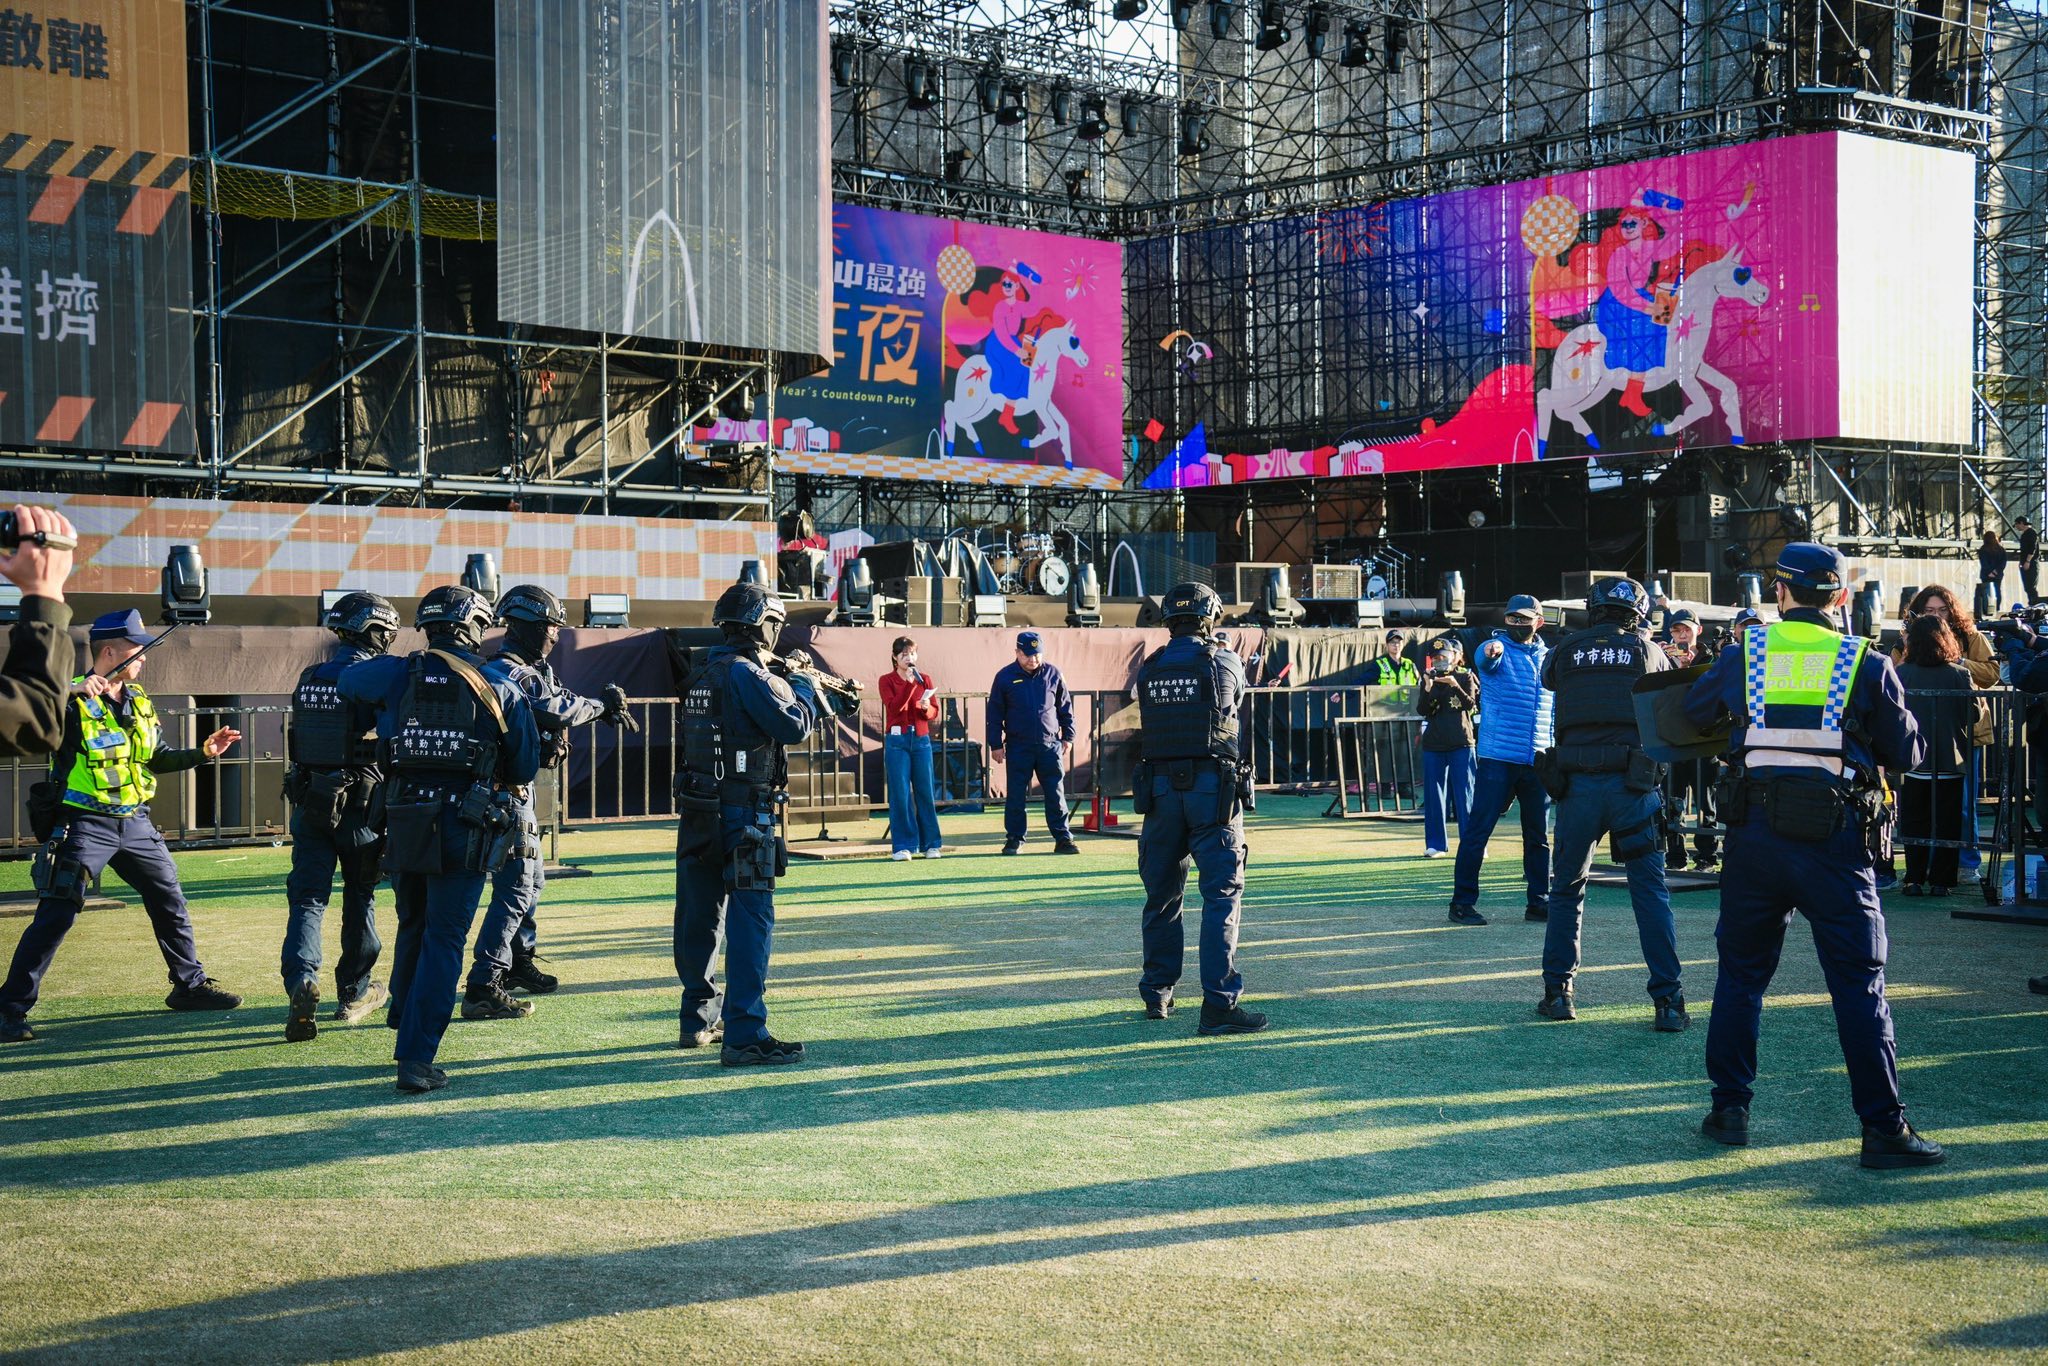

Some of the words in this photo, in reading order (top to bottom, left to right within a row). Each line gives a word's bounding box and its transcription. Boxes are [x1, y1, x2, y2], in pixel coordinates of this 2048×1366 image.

[830, 301, 923, 385] 夜
[821, 389, 883, 403] Countdown
[886, 394, 917, 407] Party
[1573, 647, 1632, 666] 中市特勤
[1769, 653, 1830, 678] 警察
[1766, 679, 1827, 689] POLICE
[1150, 686, 1195, 698] 特勤中隊
[402, 728, 465, 739] 臺中市政府警察局
[404, 738, 461, 751] 特勤中隊
